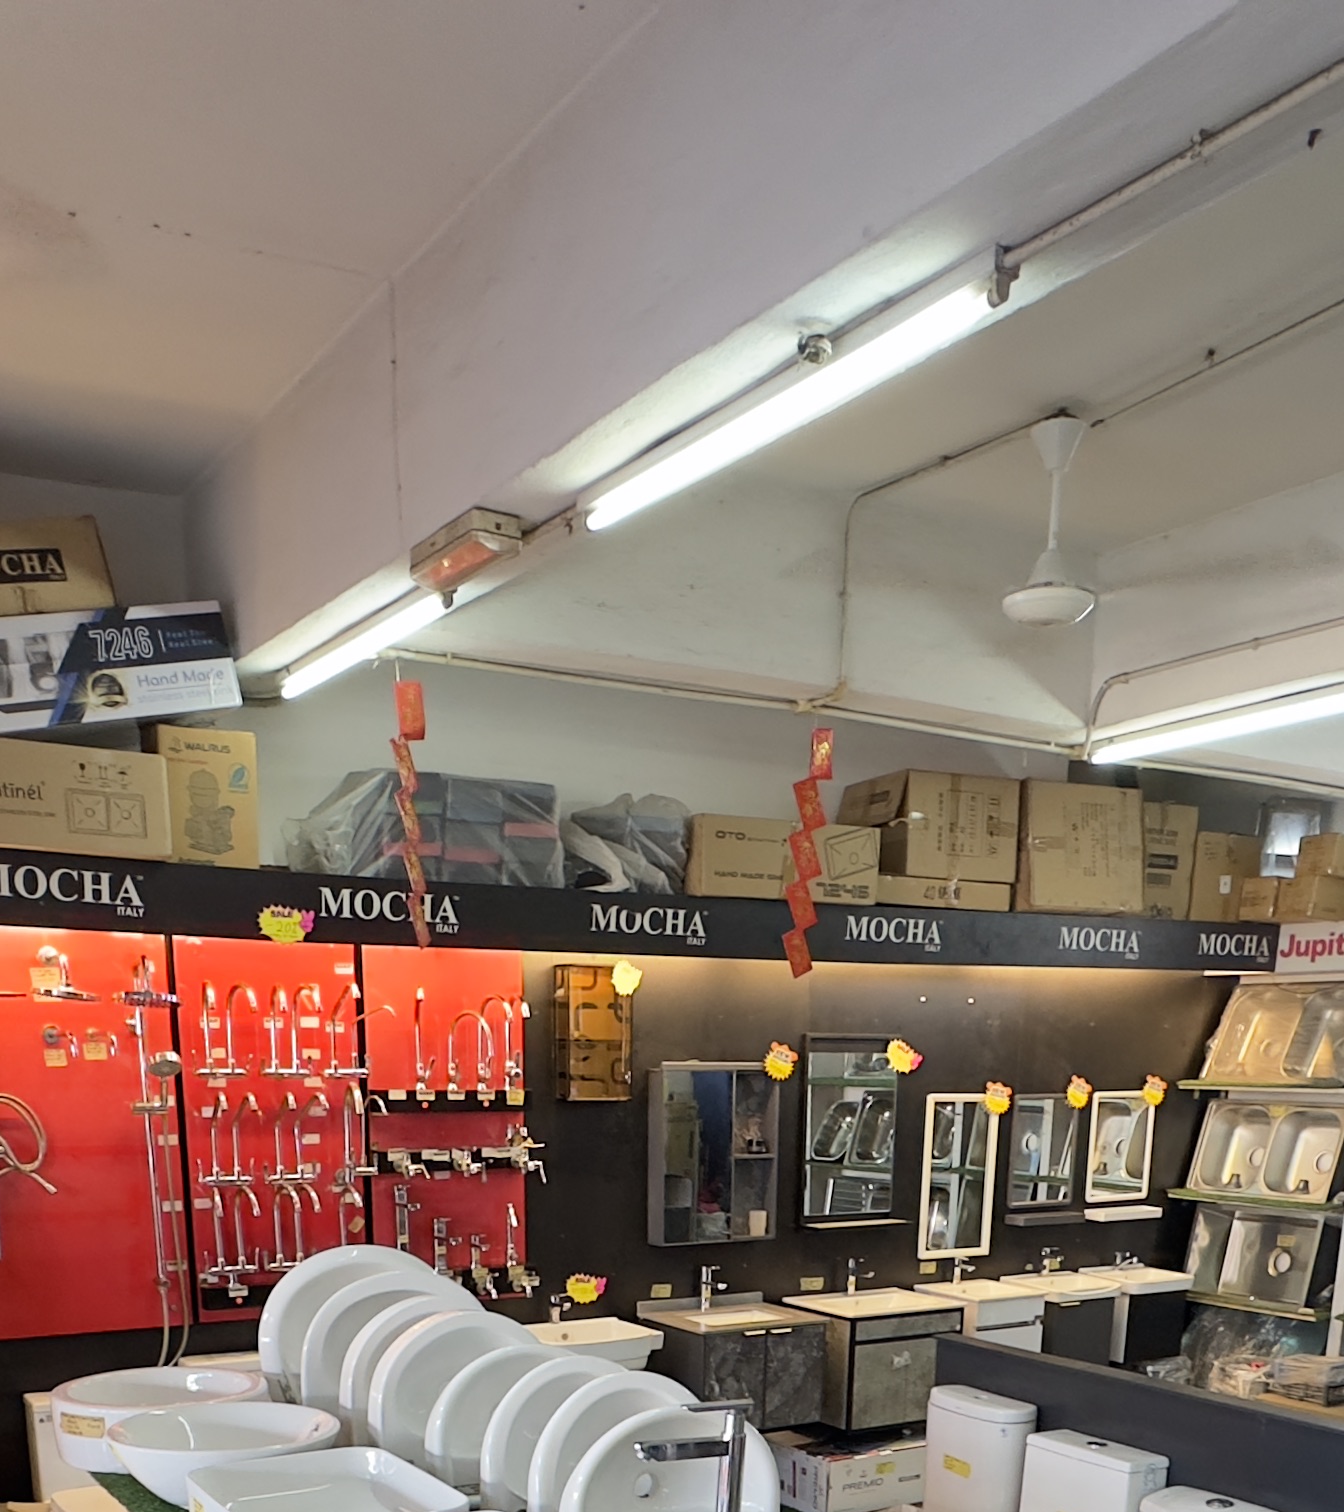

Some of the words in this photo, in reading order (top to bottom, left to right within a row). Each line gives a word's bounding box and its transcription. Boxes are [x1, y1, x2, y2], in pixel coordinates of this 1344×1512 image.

[88, 625, 154, 662] 7246
[137, 672, 177, 688] Hand
[183, 741, 231, 753] WALRUS
[715, 830, 747, 841] OTO
[117, 906, 145, 918] ITALY
[318, 886, 459, 924] MOCHA
[590, 903, 706, 937] MOCHA
[436, 923, 460, 934] ITALY
[845, 915, 941, 945] MOCHA
[687, 936, 707, 946] ITALY
[1059, 926, 1140, 953] MOCHA
[1197, 932, 1269, 958] MOCHA
[842, 1477, 884, 1492] PREMIO
